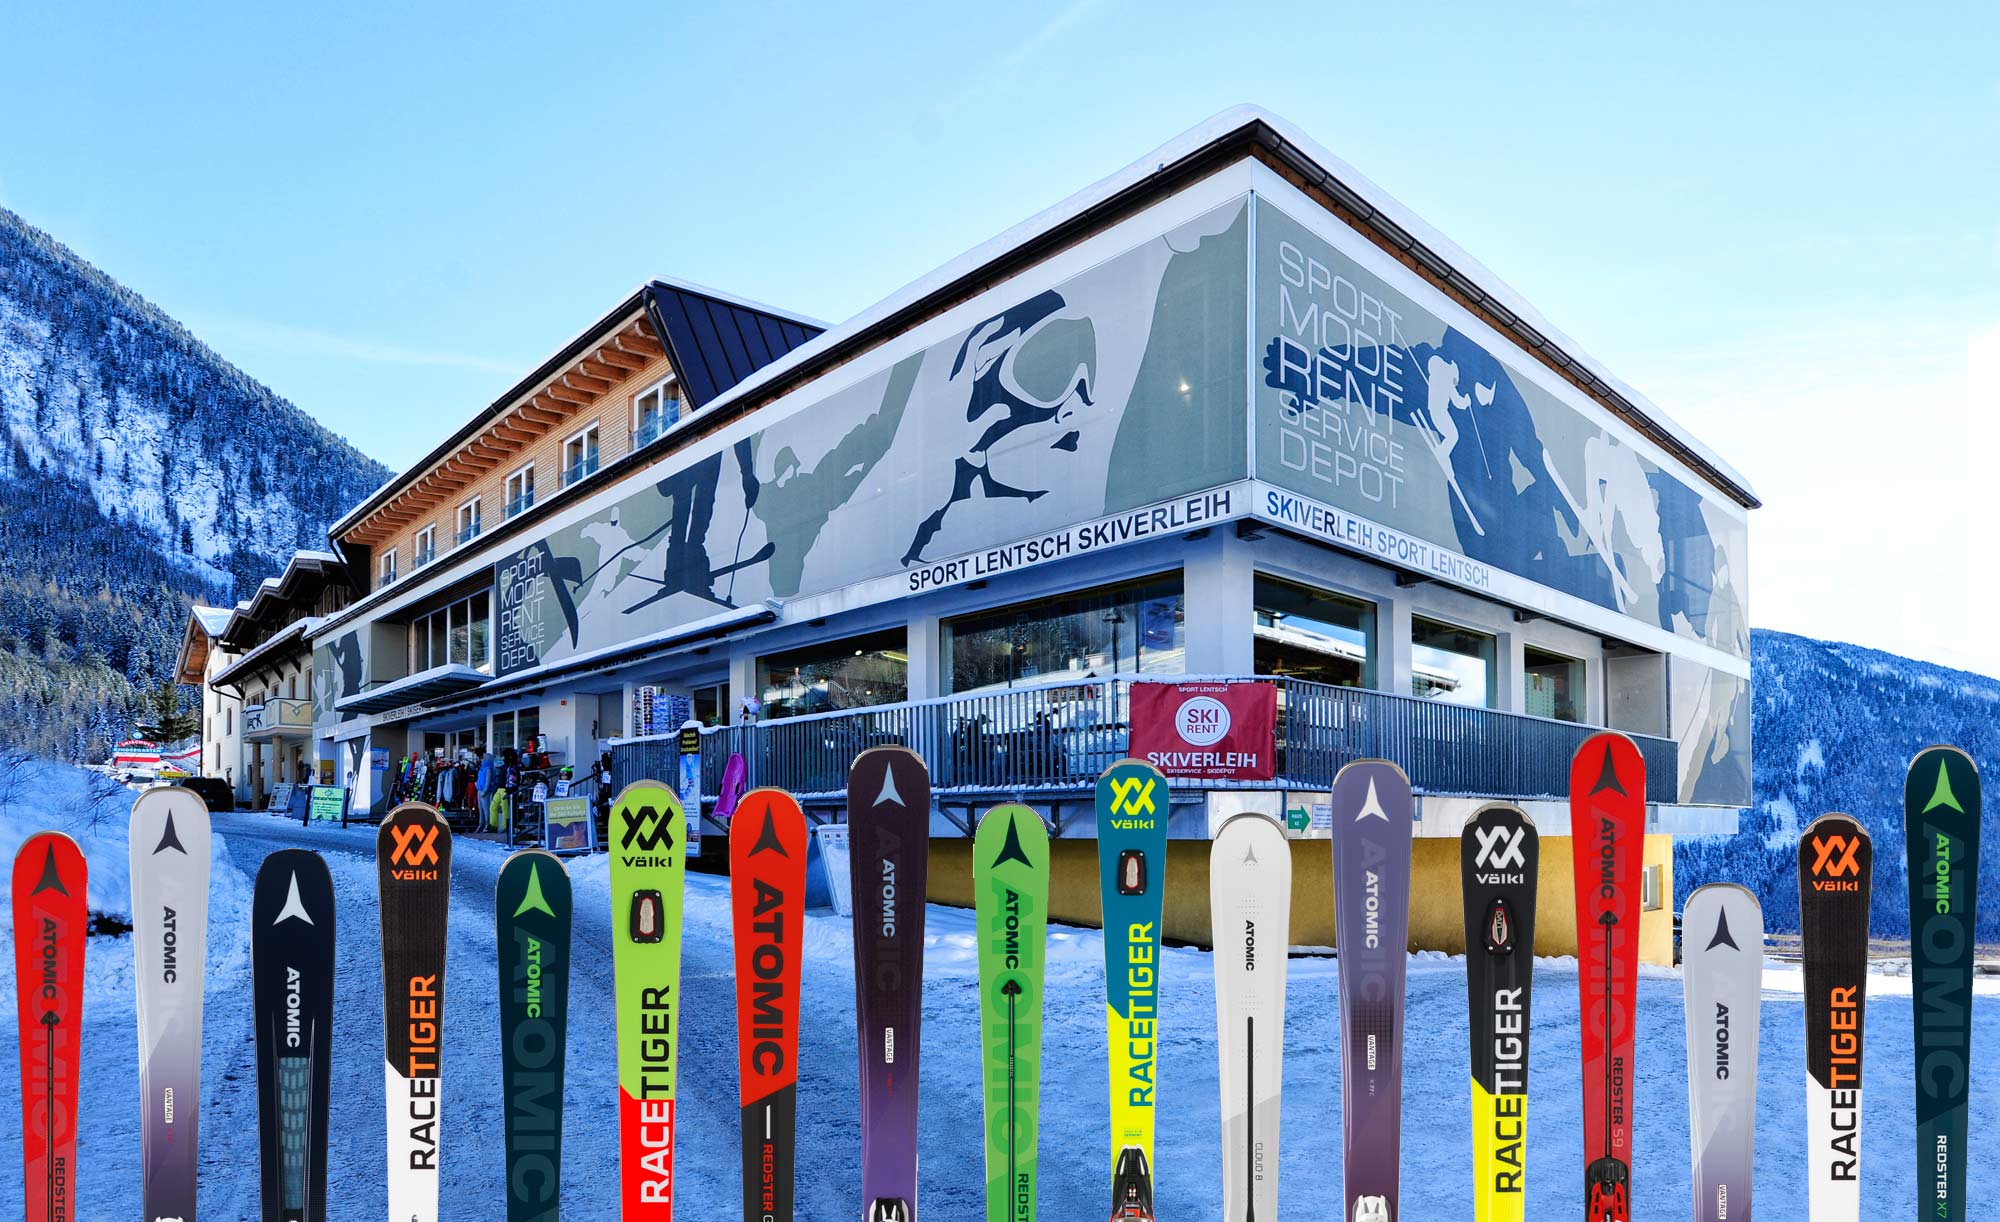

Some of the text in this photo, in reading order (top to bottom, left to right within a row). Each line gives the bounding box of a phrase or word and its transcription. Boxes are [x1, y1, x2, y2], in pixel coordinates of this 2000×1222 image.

[1279, 240, 1403, 341] SPORT
[1279, 284, 1403, 392] MODE
[1279, 334, 1403, 435] RENT
[1279, 390, 1404, 473] SERVICE
[1279, 431, 1404, 509] DEPOT
[501, 551, 544, 588] SPORT
[909, 491, 1230, 591] SPORT LENTSCH SKIVERLEIH
[1266, 491, 1489, 588] SKIVERLEIH SPORT LENTSCH
[501, 573, 544, 610] MODE
[501, 596, 544, 634] RENT
[501, 622, 544, 651] SERVICE
[501, 640, 544, 670] DEPOT
[1186, 724, 1218, 733] RENT
[1187, 708, 1219, 724] SKI
[1147, 751, 1257, 768] SKIVERLEIH
[621, 855, 673, 868] Völkl
[1110, 819, 1154, 829] Völkl
[1601, 818, 1615, 900] ATOMIC
[391, 868, 438, 881] Völkl
[882, 859, 895, 938] ATOMIC
[1366, 870, 1378, 949] ATOMIC
[1476, 873, 1524, 884] Völkl
[1813, 880, 1858, 892] Völkl
[1936, 832, 1950, 915] ATOMIC
[43, 917, 57, 1000] ATOMIC
[163, 906, 176, 984] ATOMIC
[1004, 888, 1018, 970] ATOMIC
[1245, 919, 1255, 972] ATOMIC
[1589, 806, 1624, 1044] ATOMIC
[1921, 821, 1964, 1099] ATOMIC
[286, 966, 300, 1048] ATOMIC
[527, 937, 541, 1018] ATOMIC
[752, 877, 784, 1077] ATOMIC
[1129, 921, 1153, 1107] RACETIGER
[409, 973, 436, 1170] RACETIGER
[512, 925, 556, 1203] ATOMIC
[1716, 1002, 1729, 1080] ATOMIC
[640, 985, 670, 1203] RACETIGER
[1495, 987, 1522, 1193] RACETIGER
[1613, 1056, 1624, 1148] REDSTER S9
[1830, 985, 1857, 1181] RACETIGER
[55, 1157, 66, 1222] REDSTER
[763, 1144, 774, 1211] REDSTER
[1018, 1173, 1029, 1222] REDST
[1255, 1142, 1263, 1173] CLOUD
[1937, 1135, 1947, 1219] REDSTER X7
